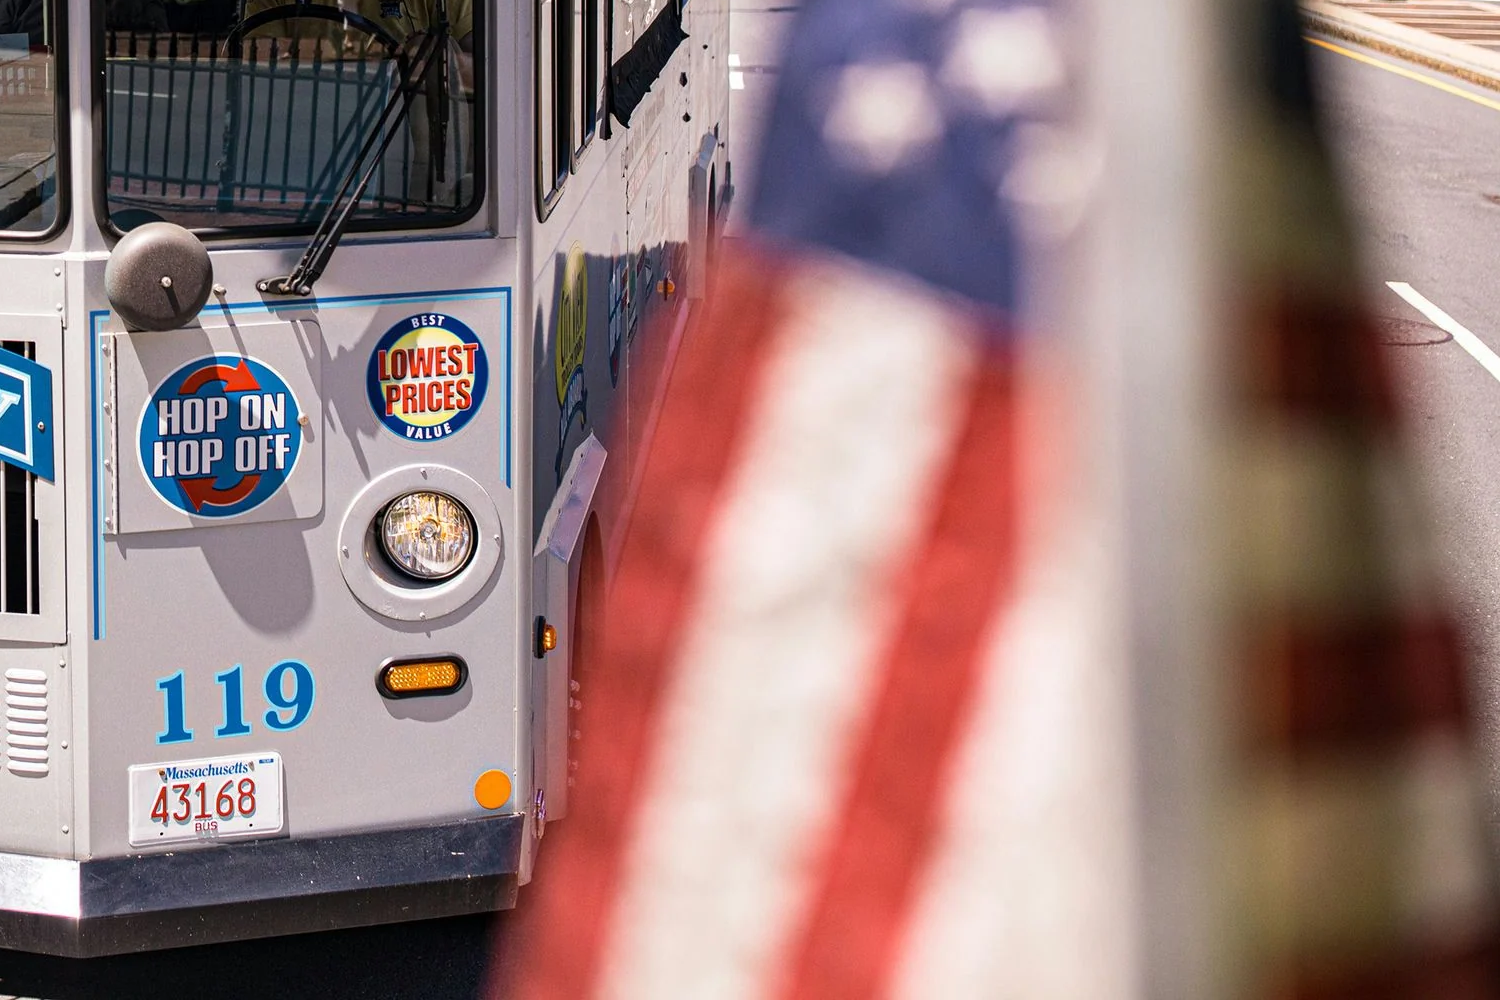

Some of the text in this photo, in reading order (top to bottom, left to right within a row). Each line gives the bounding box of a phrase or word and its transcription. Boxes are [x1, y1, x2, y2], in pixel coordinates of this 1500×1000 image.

[411, 314, 445, 329] BEST
[378, 343, 479, 382] LOWEST
[157, 392, 286, 437] HOP ON
[385, 379, 473, 417] PRICES
[406, 422, 453, 439] VALUE
[152, 432, 291, 478] HOP OFF
[155, 658, 316, 745] 119
[165, 761, 249, 780] Massachusetts
[150, 777, 256, 825] 43168
[195, 820, 218, 832] BUS
